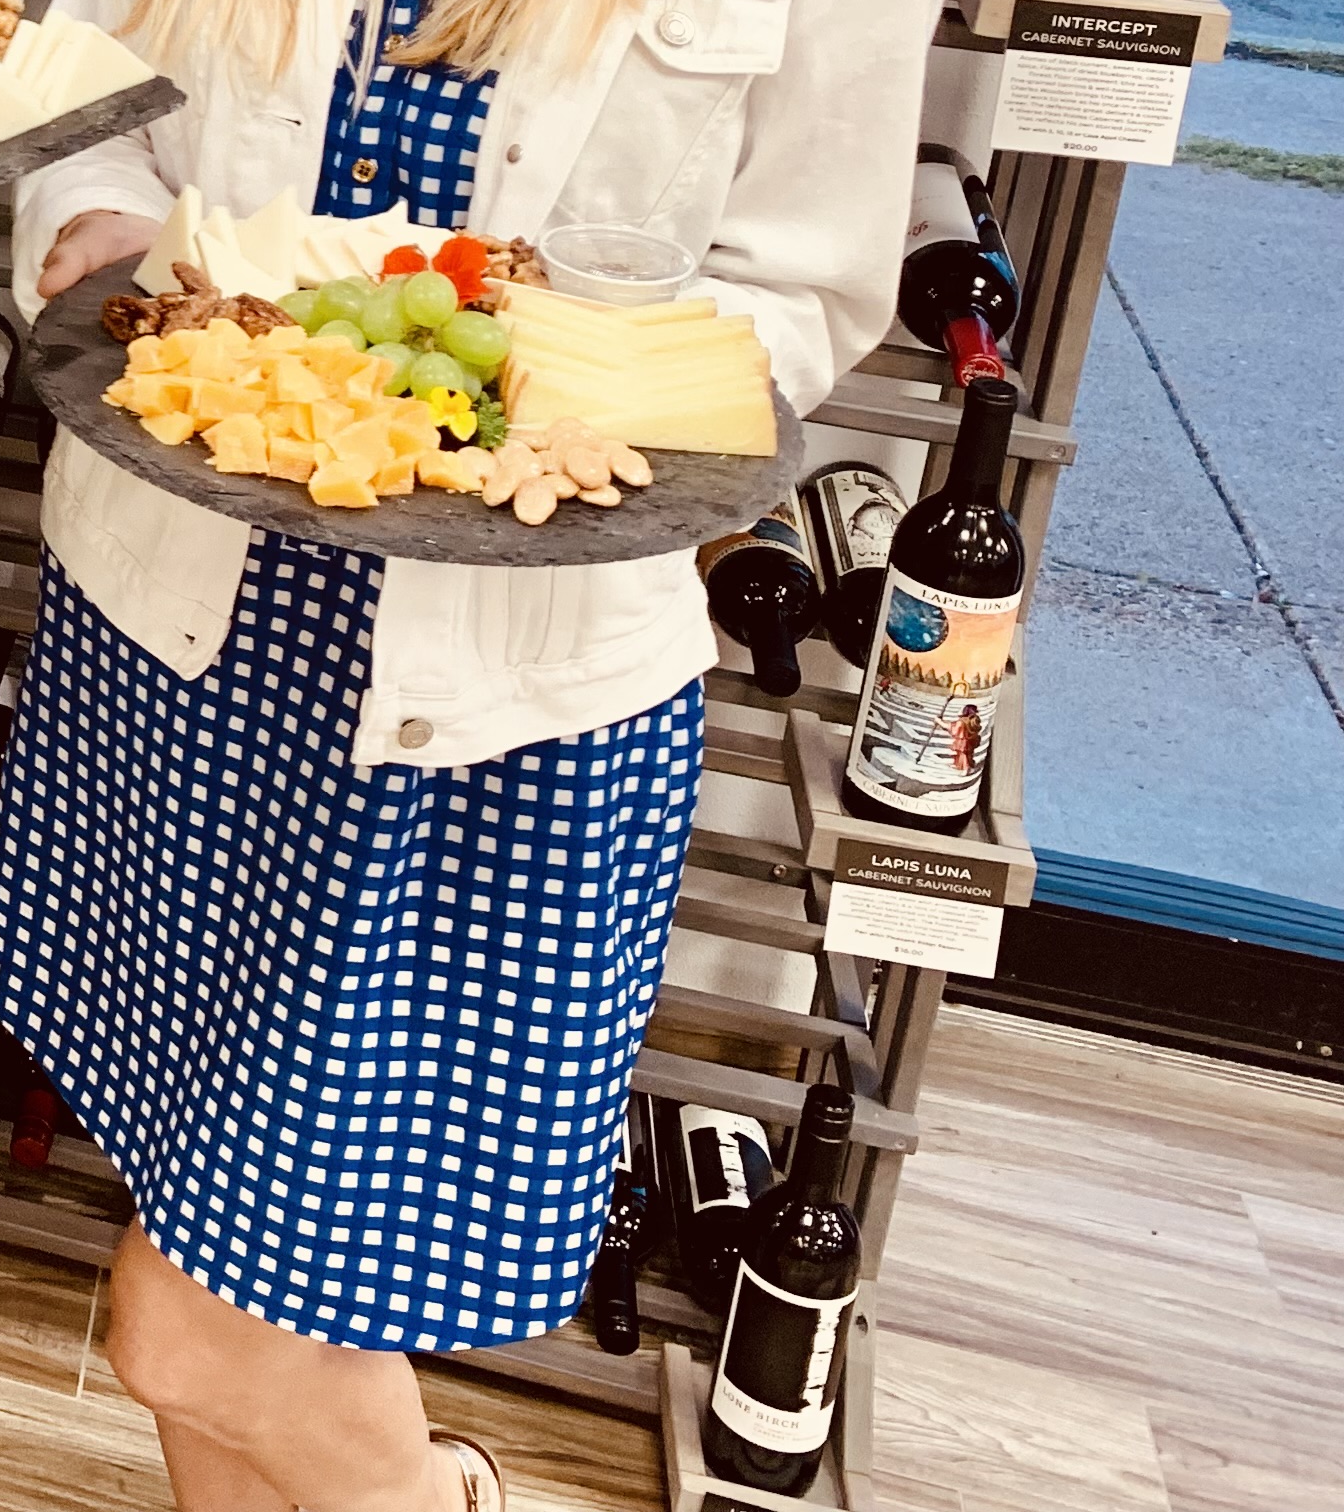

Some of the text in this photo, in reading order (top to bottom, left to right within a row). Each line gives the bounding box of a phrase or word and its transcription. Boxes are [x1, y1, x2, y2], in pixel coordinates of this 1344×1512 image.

[1051, 15, 1158, 37] INTERCEPT
[1021, 31, 1181, 56] CABERNET SAUVIGNON
[1063, 143, 1098, 152] $20.00
[921, 590, 1011, 610] LAPIS LUNA
[872, 855, 972, 880] LAPIS LUNA
[847, 868, 992, 898] CABERNET SAUVIGNON
[723, 1386, 800, 1429] LONE BIRCH
